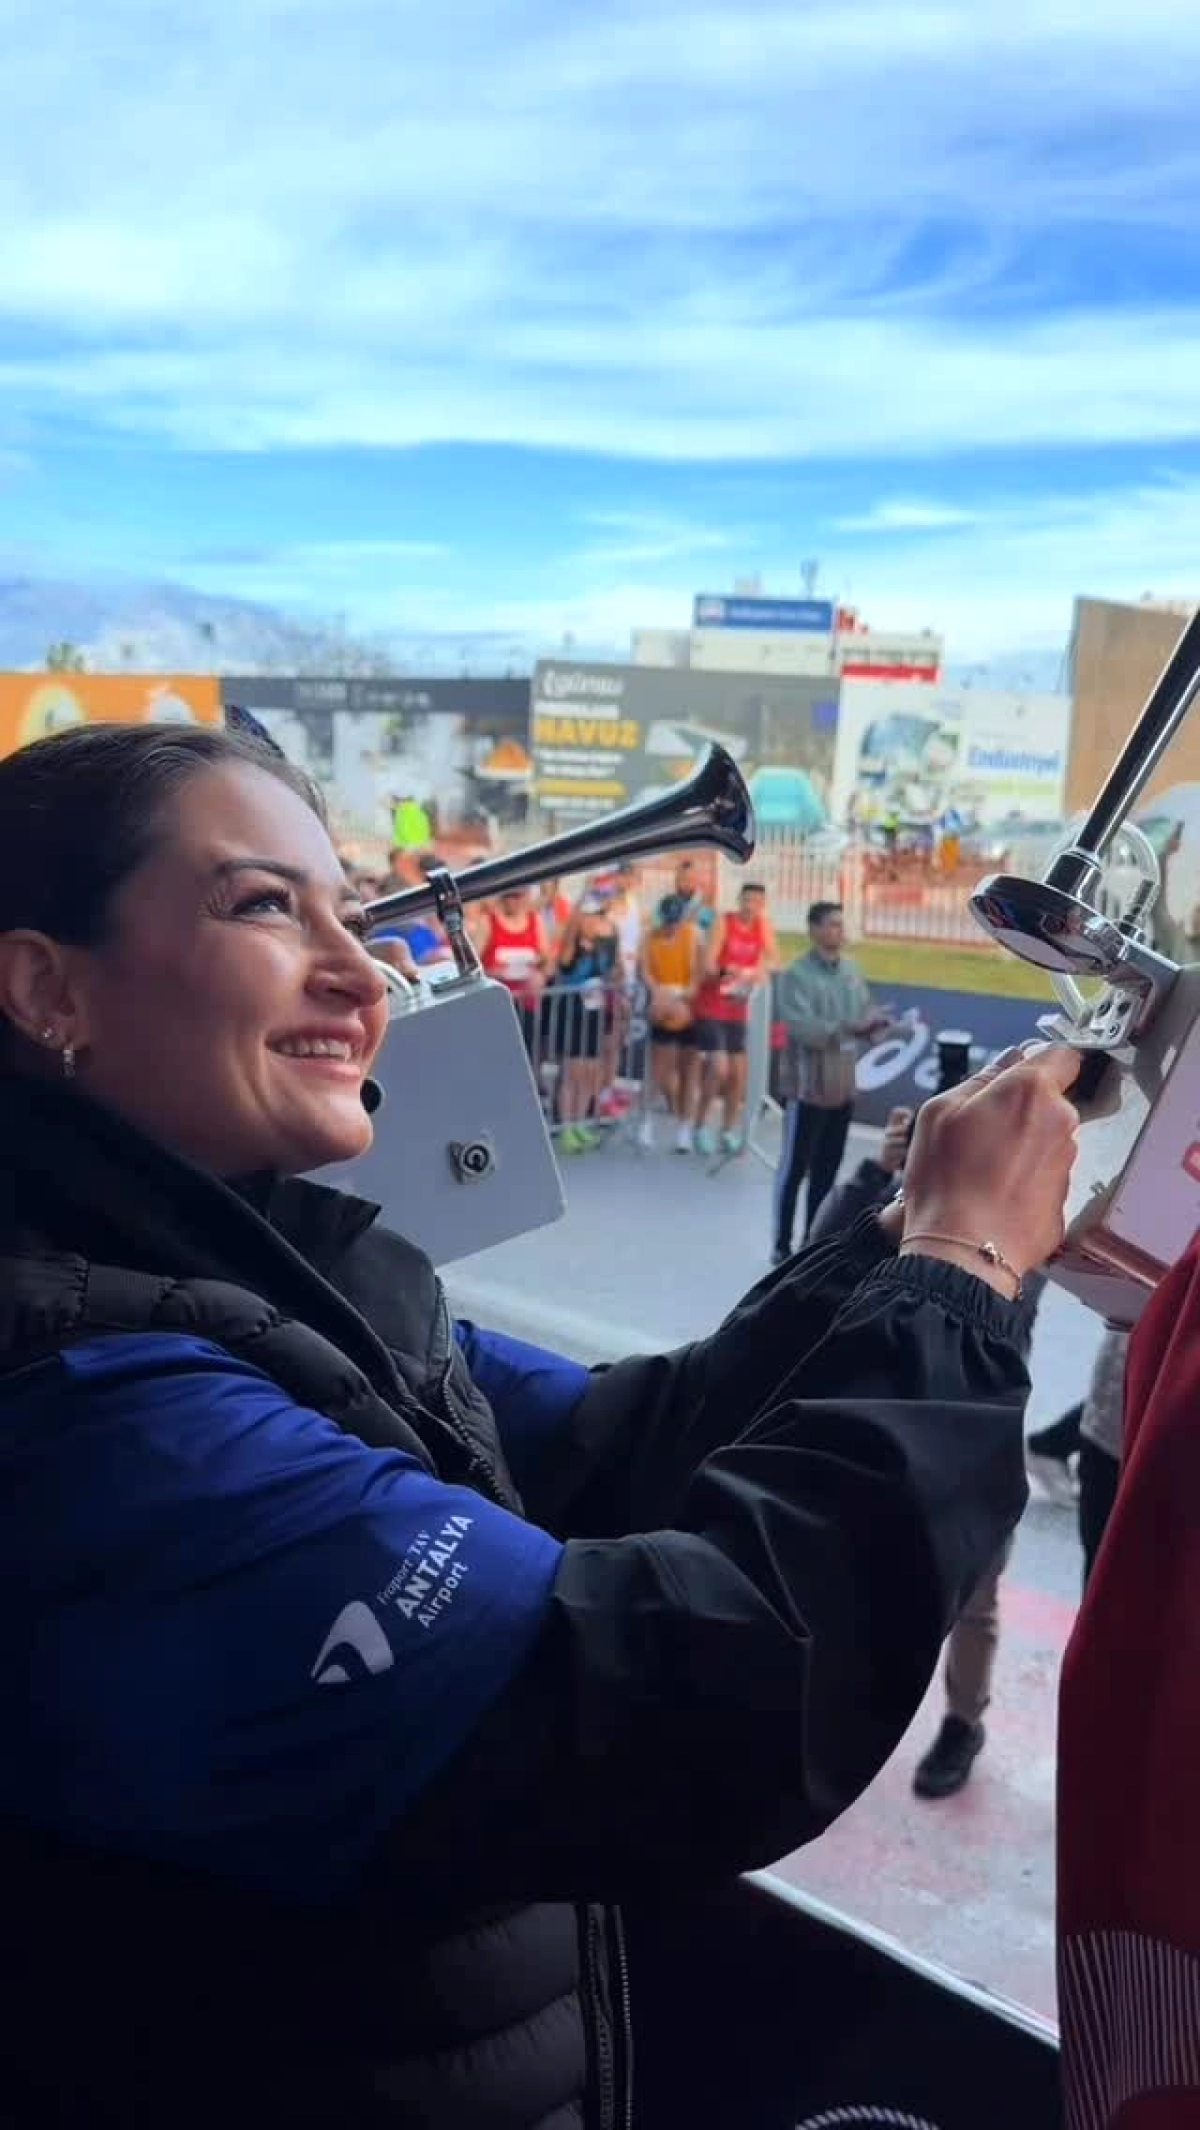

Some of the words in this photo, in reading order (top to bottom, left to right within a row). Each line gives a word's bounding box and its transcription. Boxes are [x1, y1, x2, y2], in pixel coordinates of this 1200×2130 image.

[536, 719, 638, 750] HAVUZ
[376, 1558, 414, 1605] Fraport
[395, 1515, 474, 1619] ANTALYA
[417, 1561, 469, 1628] Airport
